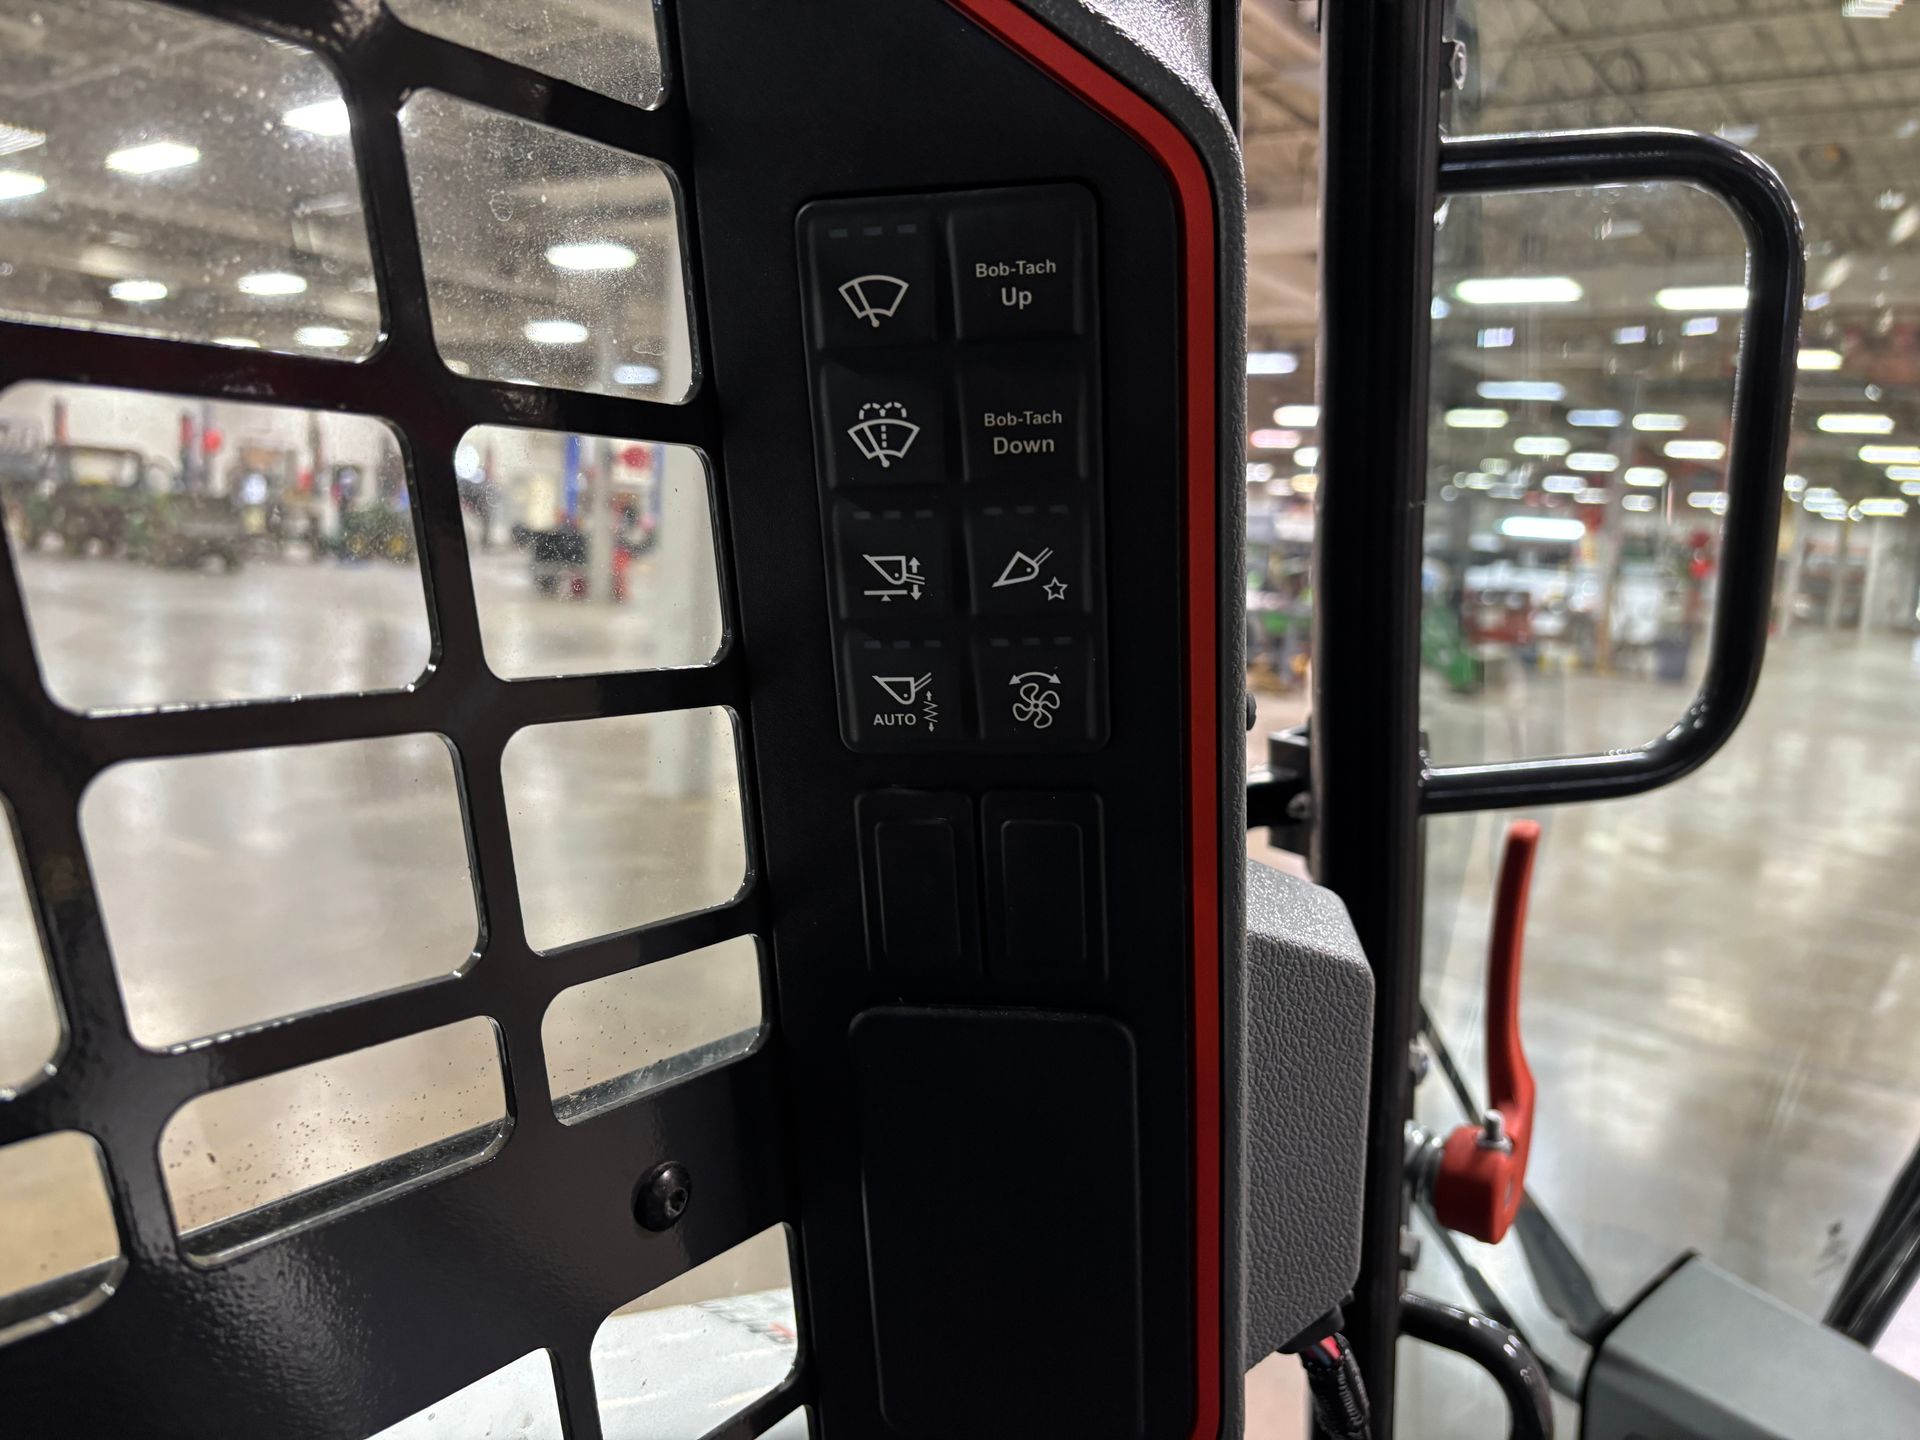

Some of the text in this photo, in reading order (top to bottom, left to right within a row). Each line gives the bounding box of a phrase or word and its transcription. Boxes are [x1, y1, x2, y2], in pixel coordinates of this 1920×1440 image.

[975, 259, 1057, 278] Bob-Tach
[1001, 286, 1033, 310] Up
[983, 409, 1063, 427] Bob-Tach
[993, 436, 1055, 455] Down
[873, 713, 917, 726] AUTO
